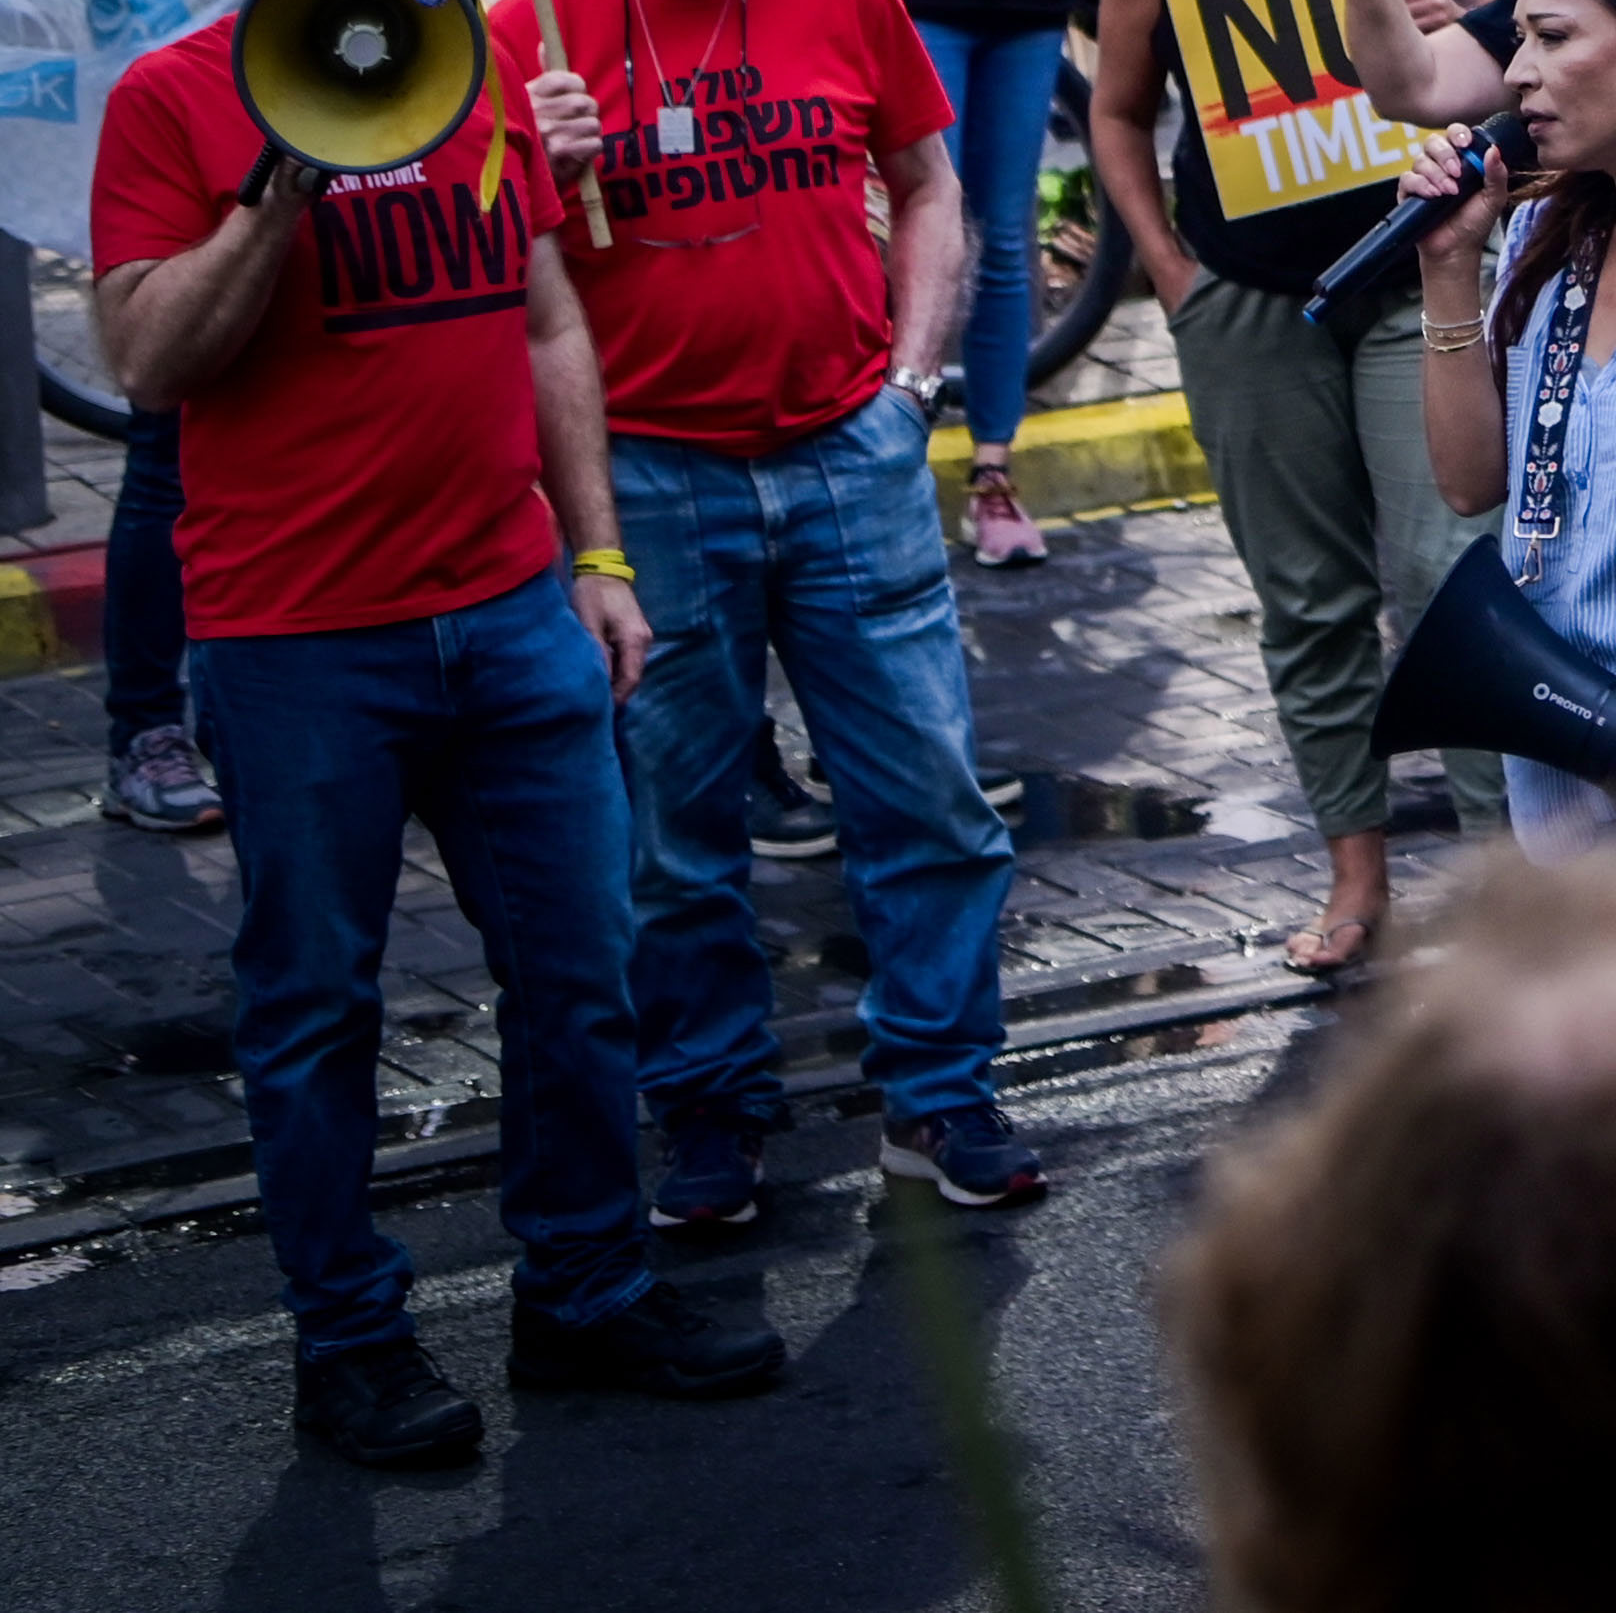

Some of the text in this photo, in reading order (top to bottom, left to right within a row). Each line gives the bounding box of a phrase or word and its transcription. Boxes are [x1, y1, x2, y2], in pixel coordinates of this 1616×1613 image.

[602, 144, 840, 220] החטופים
[1239, 93, 1424, 193] TIME!
[311, 179, 528, 308] NOW!
[1548, 692, 1606, 727] PROXTOE
